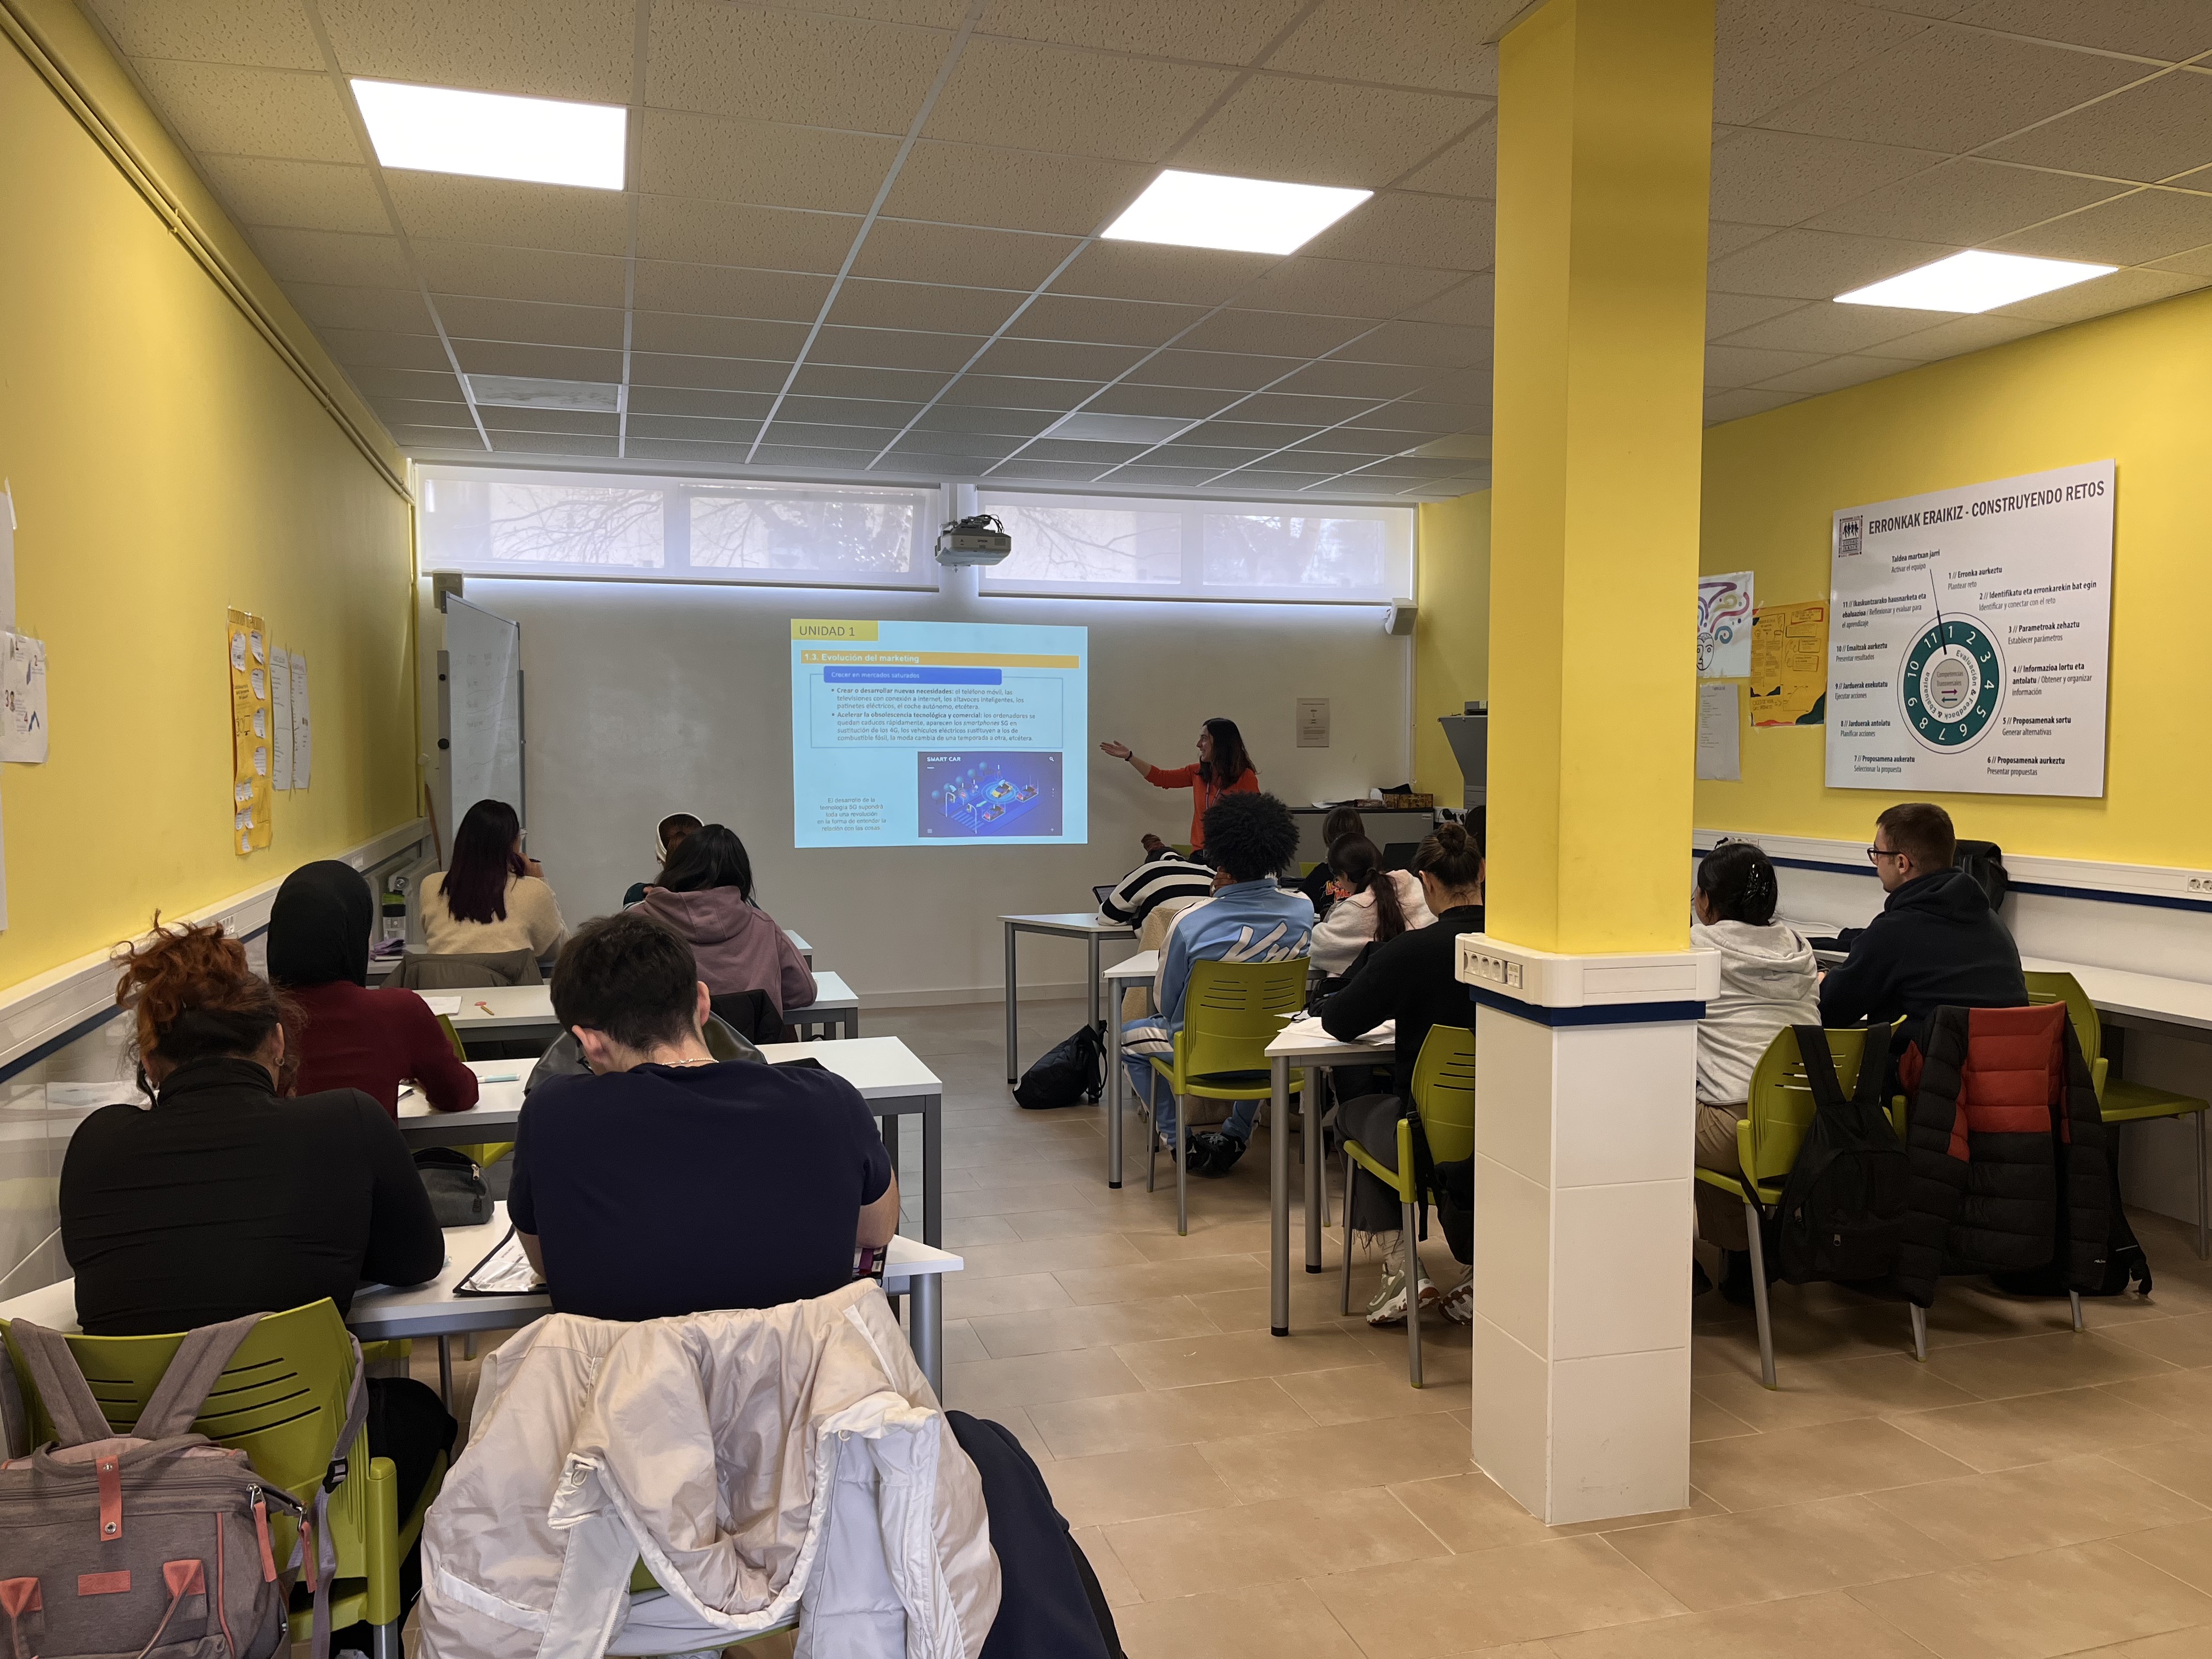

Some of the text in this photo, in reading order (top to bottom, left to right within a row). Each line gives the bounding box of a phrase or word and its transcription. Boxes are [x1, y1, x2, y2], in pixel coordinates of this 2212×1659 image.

[1869, 481, 2104, 535] ERRONKAK ERAIKIZ CONSTRUYENDO RETOS
[1908, 551, 1928, 560] martxan
[1929, 549, 1940, 559] jarri
[1957, 569, 1978, 578] Erronka
[1978, 567, 2002, 575] aurkeztu
[1948, 582, 1966, 590] Plantear
[1989, 589, 2022, 599] Identifikatu
[2034, 583, 2071, 594] erronkarekin
[2083, 580, 2096, 590] egin
[1979, 602, 2003, 611] Identificar
[2008, 600, 2029, 608] conectar
[799, 626, 855, 636] UNIDAD 1
[1948, 626, 1953, 638] 1
[2018, 622, 2056, 632] Parametroak
[2057, 621, 2080, 629] zehaztu
[1923, 633, 1937, 648] 11
[1966, 631, 1976, 645] 2
[2008, 635, 2063, 645] Establecer parámetros
[879, 655, 919, 663] marketing
[1980, 652, 1991, 663] 3
[1908, 661, 1919, 677] 10
[1956, 650, 1977, 686] Evaluación
[2023, 664, 2057, 673] Informazioa
[1984, 680, 1994, 690] 4
[2012, 676, 2036, 685] antolatu
[2067, 674, 2092, 684] organizar
[1908, 697, 1918, 706] 9
[1976, 706, 1986, 718] 5
[1919, 718, 1928, 729] 8
[2013, 716, 2055, 726] Proposamenak
[1938, 728, 1945, 740] 7
[1959, 724, 1967, 737] 6
[1862, 755, 1893, 764] Proposamena
[1997, 756, 2038, 765] Proposamenak
[2010, 769, 2038, 777] propuestas
